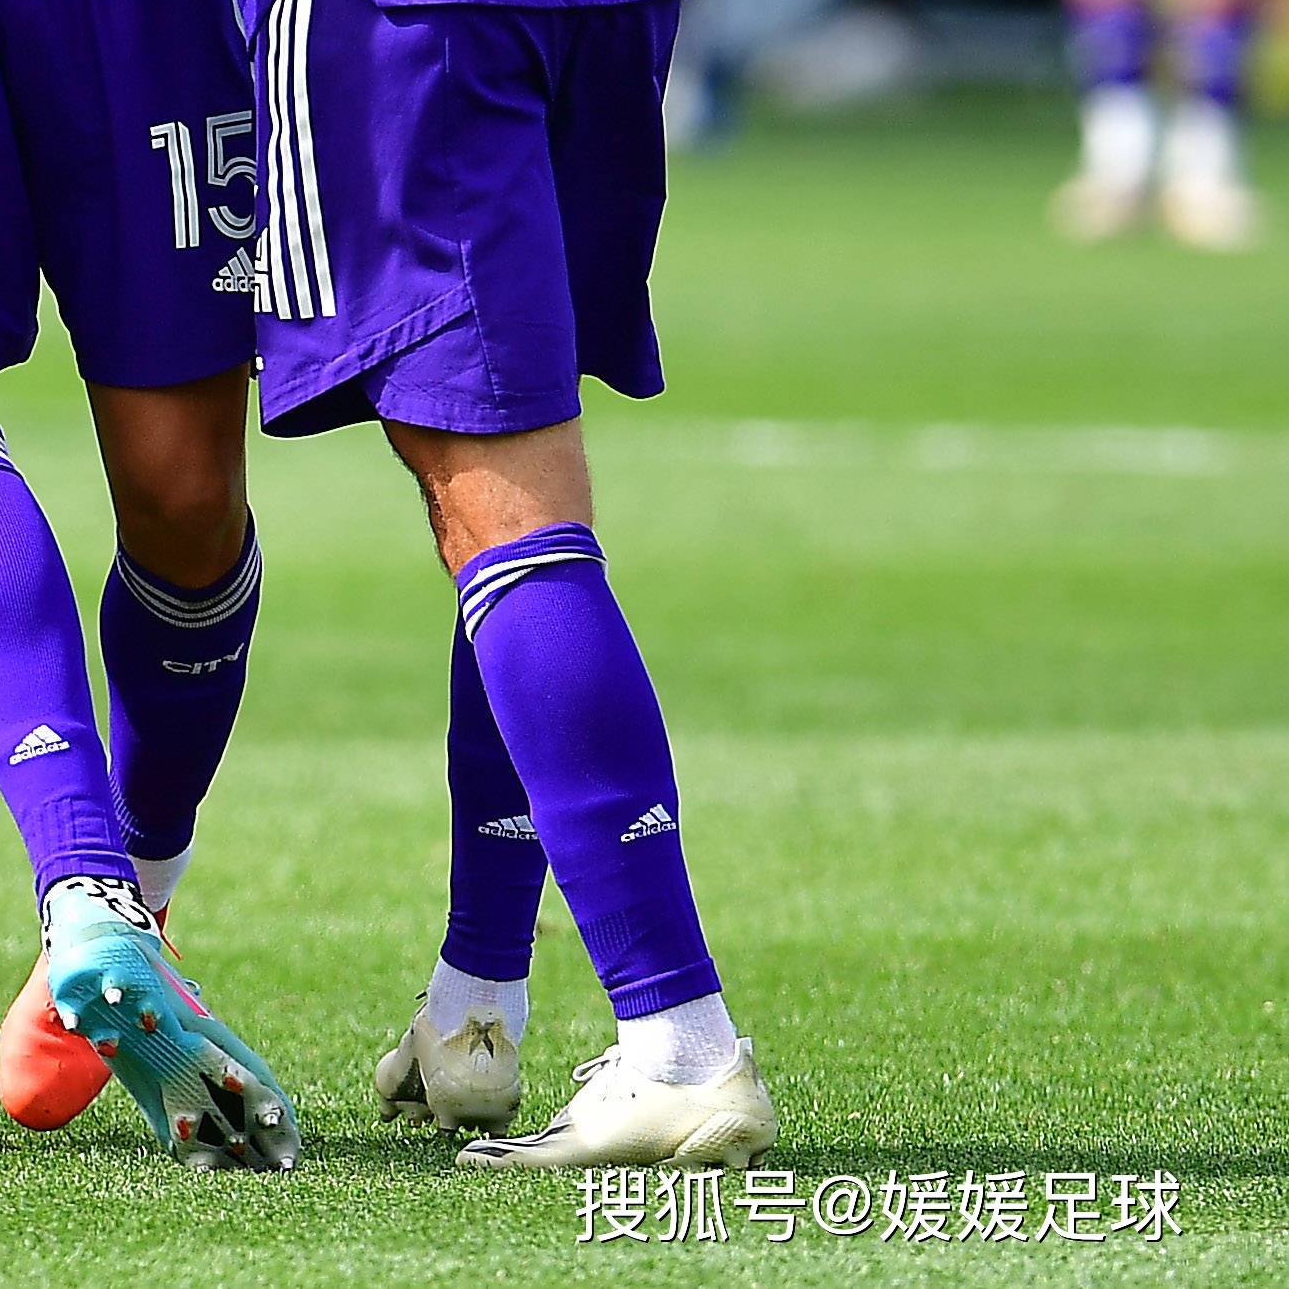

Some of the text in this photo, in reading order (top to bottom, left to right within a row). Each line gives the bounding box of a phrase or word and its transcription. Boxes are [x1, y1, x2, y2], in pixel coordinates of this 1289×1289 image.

[150, 110, 258, 248] 15
[162, 642, 245, 674] CITY
[9, 741, 70, 765] adidas
[478, 825, 539, 840] adidas
[621, 822, 676, 842] adidas
